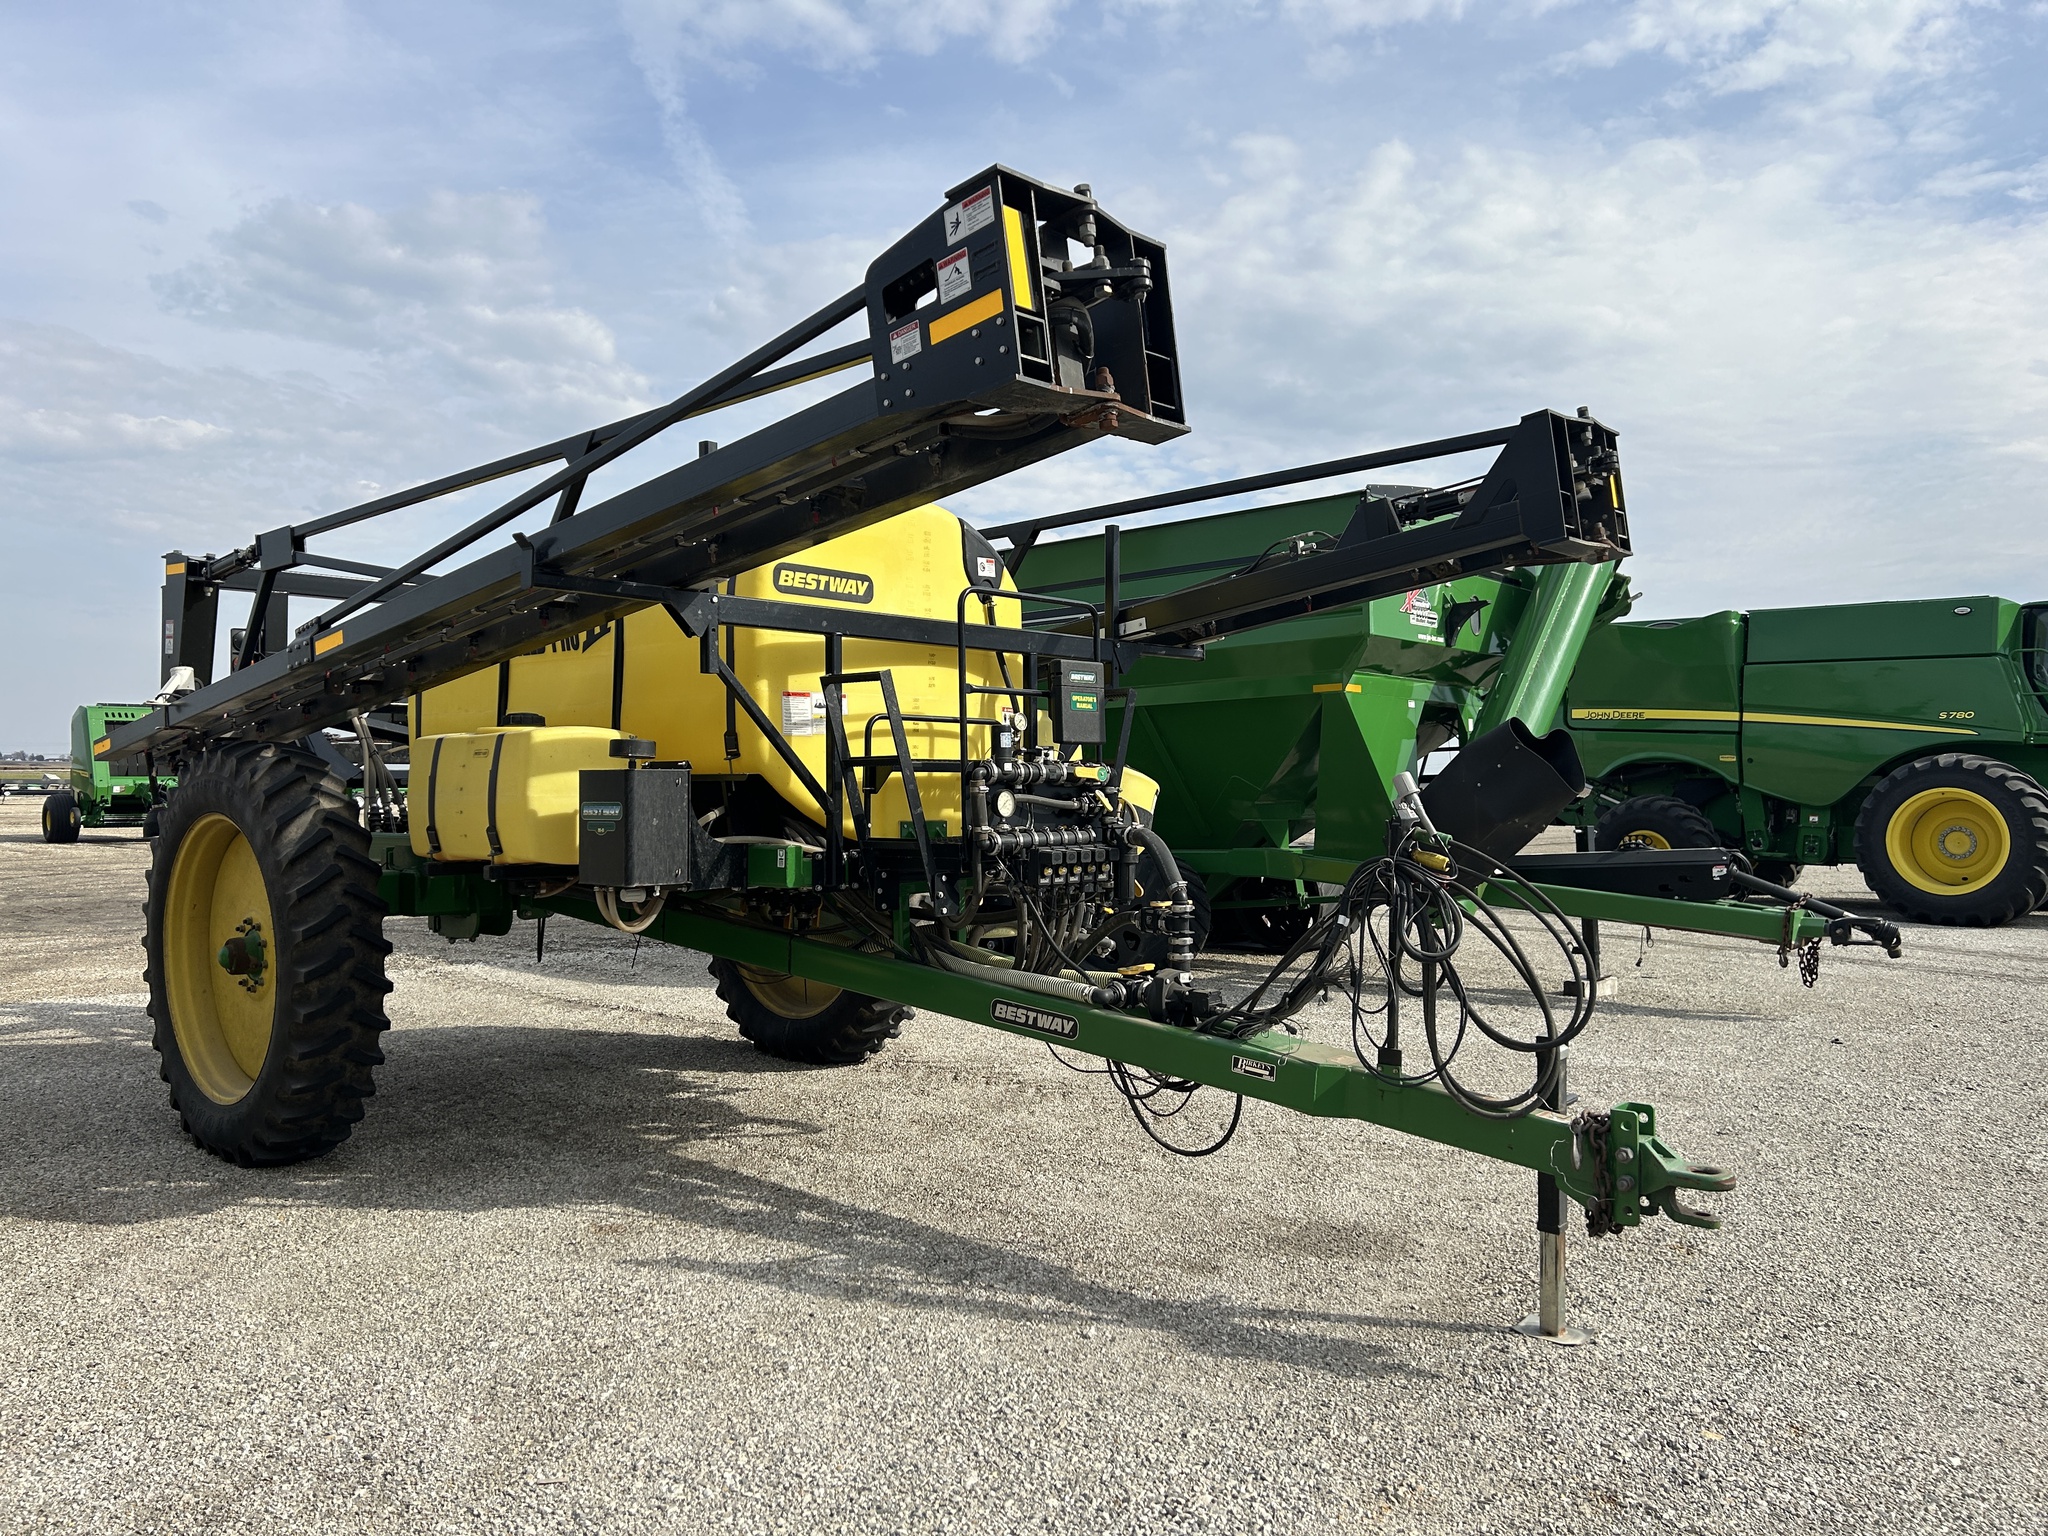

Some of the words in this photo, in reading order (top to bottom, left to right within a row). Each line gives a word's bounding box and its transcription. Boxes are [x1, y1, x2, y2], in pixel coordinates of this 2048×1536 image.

[779, 569, 869, 596] BESTWAY
[1584, 710, 1611, 719] JOHN
[1612, 710, 1646, 719] DEERE
[994, 1003, 1074, 1034] BESTWAY
